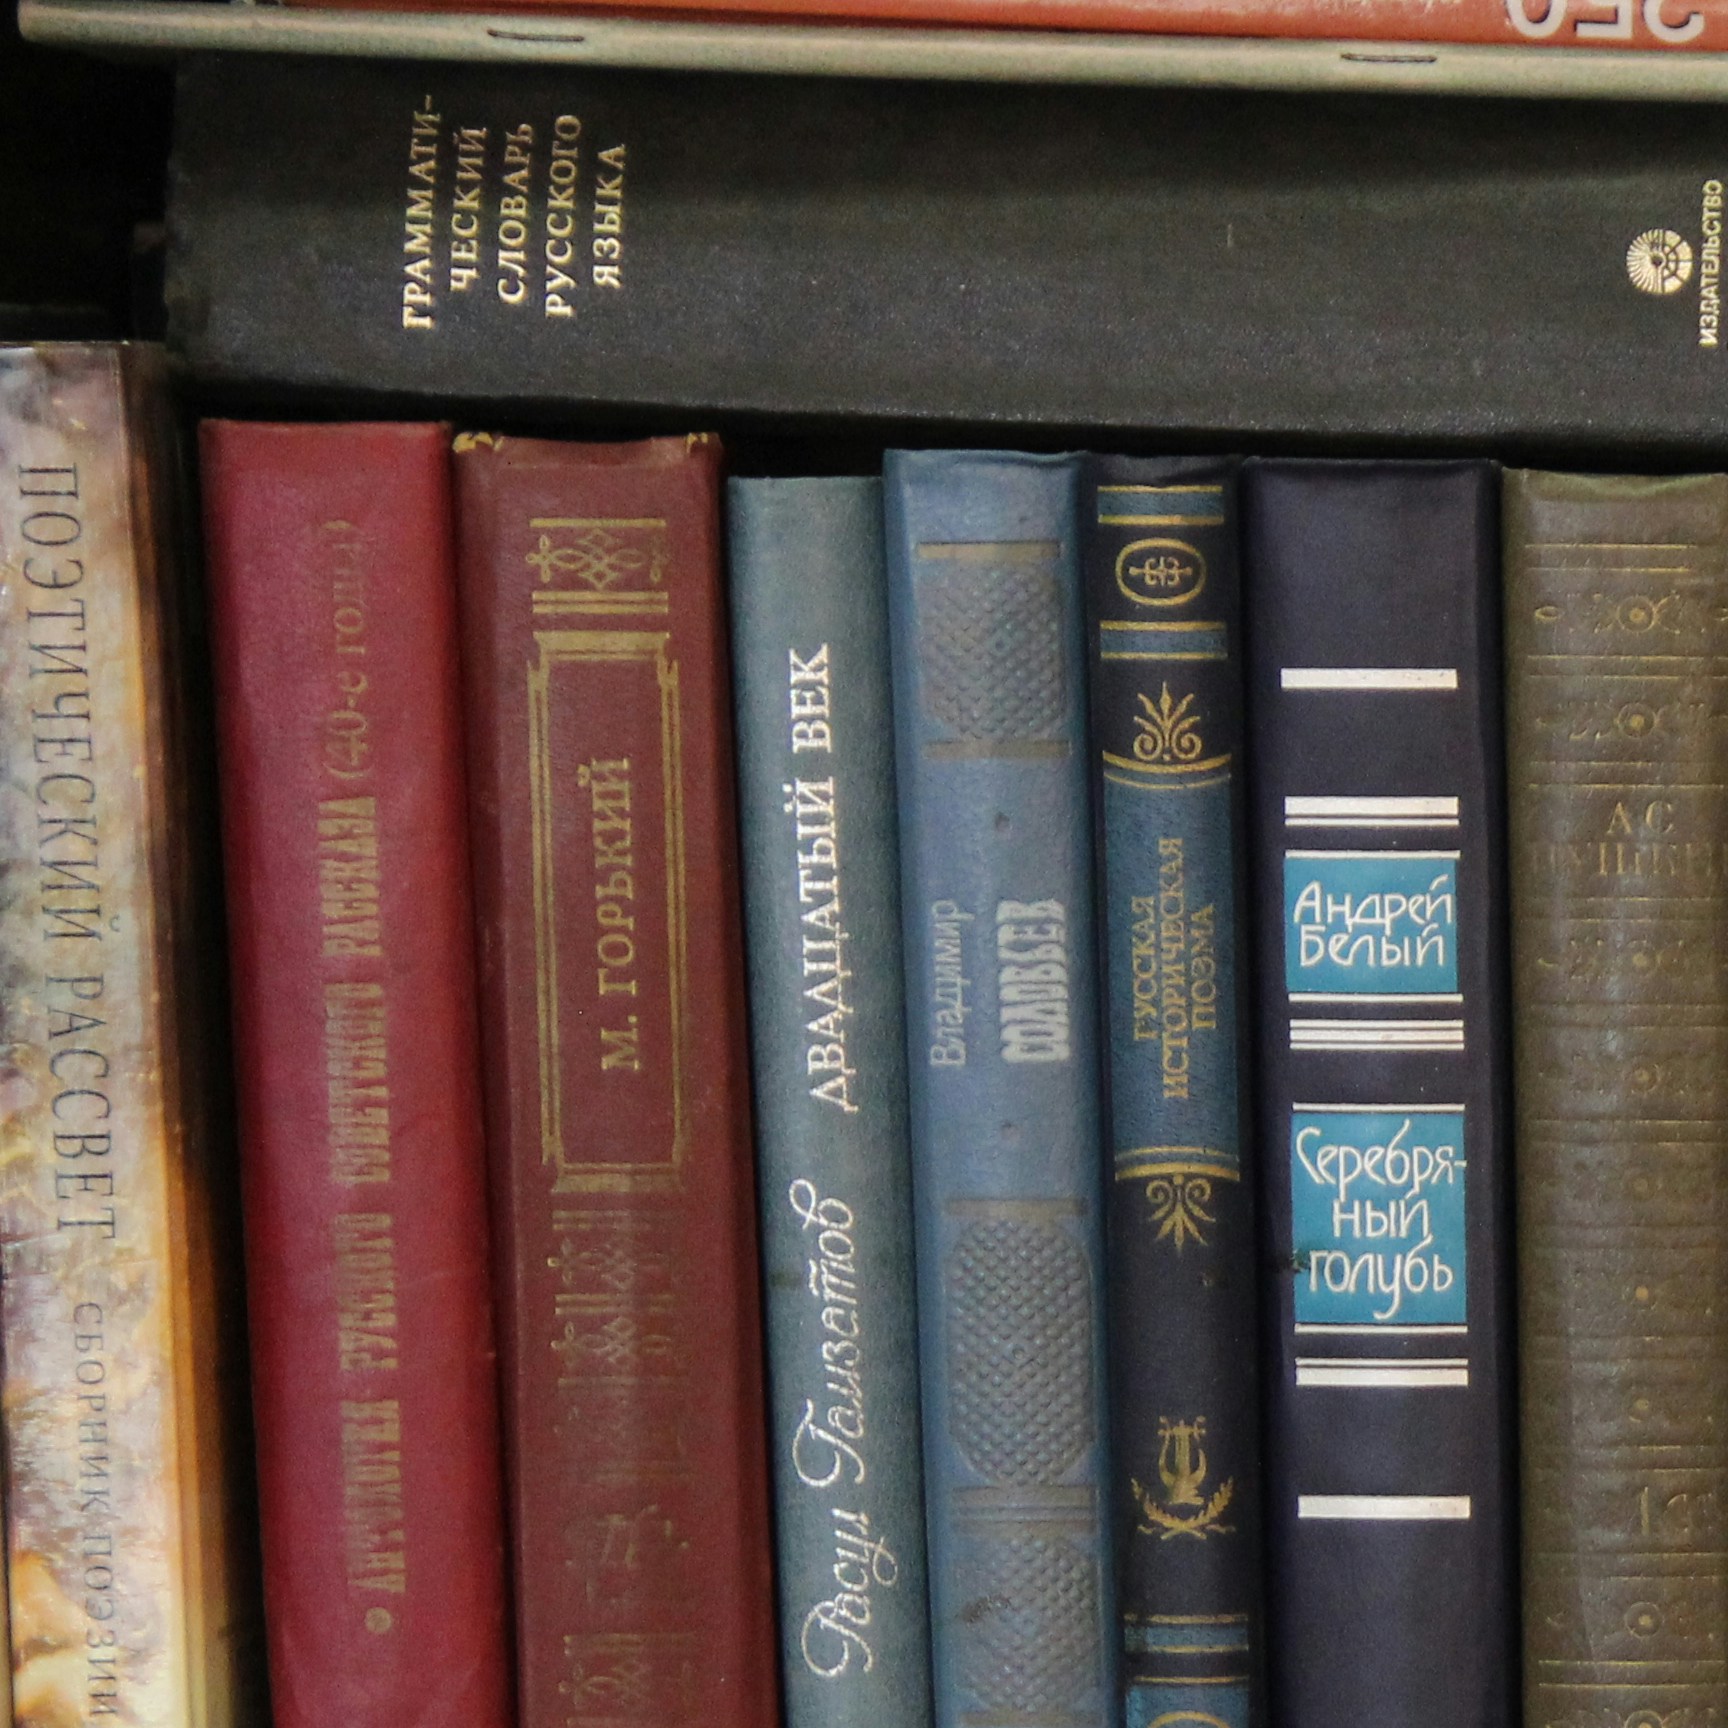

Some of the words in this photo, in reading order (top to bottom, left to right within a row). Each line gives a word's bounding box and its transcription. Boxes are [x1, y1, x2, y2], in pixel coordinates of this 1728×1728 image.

[402, 94, 441, 330] ГРАММАТИ-
[449, 126, 487, 291] ЧЕСКИЙ
[496, 122, 534, 305] СЛОВАРЬ
[544, 114, 583, 319] РУССКОГО
[592, 143, 626, 290] ЯЗЫКА
[1699, 179, 1724, 348] ИЗДАТЕЛЬСТВО
[17, 461, 121, 943] ПОЭТИЧЕСКИЙ
[788, 643, 834, 754] ВЕК
[316, 796, 383, 957] РАССКАЗА
[577, 756, 638, 997] ГОРЬКИЙ
[782, 776, 858, 1113] ДВАДЦАТЫЙ
[1293, 871, 1454, 925] Андрей
[1298, 922, 1447, 969] Белый
[599, 1015, 640, 1072] М.
[929, 898, 973, 1068] Владимир
[996, 898, 1070, 1063] СОЛОВЬЕВ
[1131, 895, 1158, 1043] РУССКАЯ
[1159, 836, 1190, 1099] ИСТОРИЧЕСКАЯ
[1190, 904, 1219, 1030] ПОЭМА
[45, 974, 117, 1240] РАССВЕТ
[322, 982, 392, 1184] СОВЕТСКОГО
[333, 1212, 398, 1372] РУССКОГО
[788, 1178, 869, 1488] Гамзатов
[71, 1300, 110, 1514] СБОРНИК
[82, 1530, 120, 1718] ПОЭЗИИ
[801, 1507, 898, 1678] Расул
